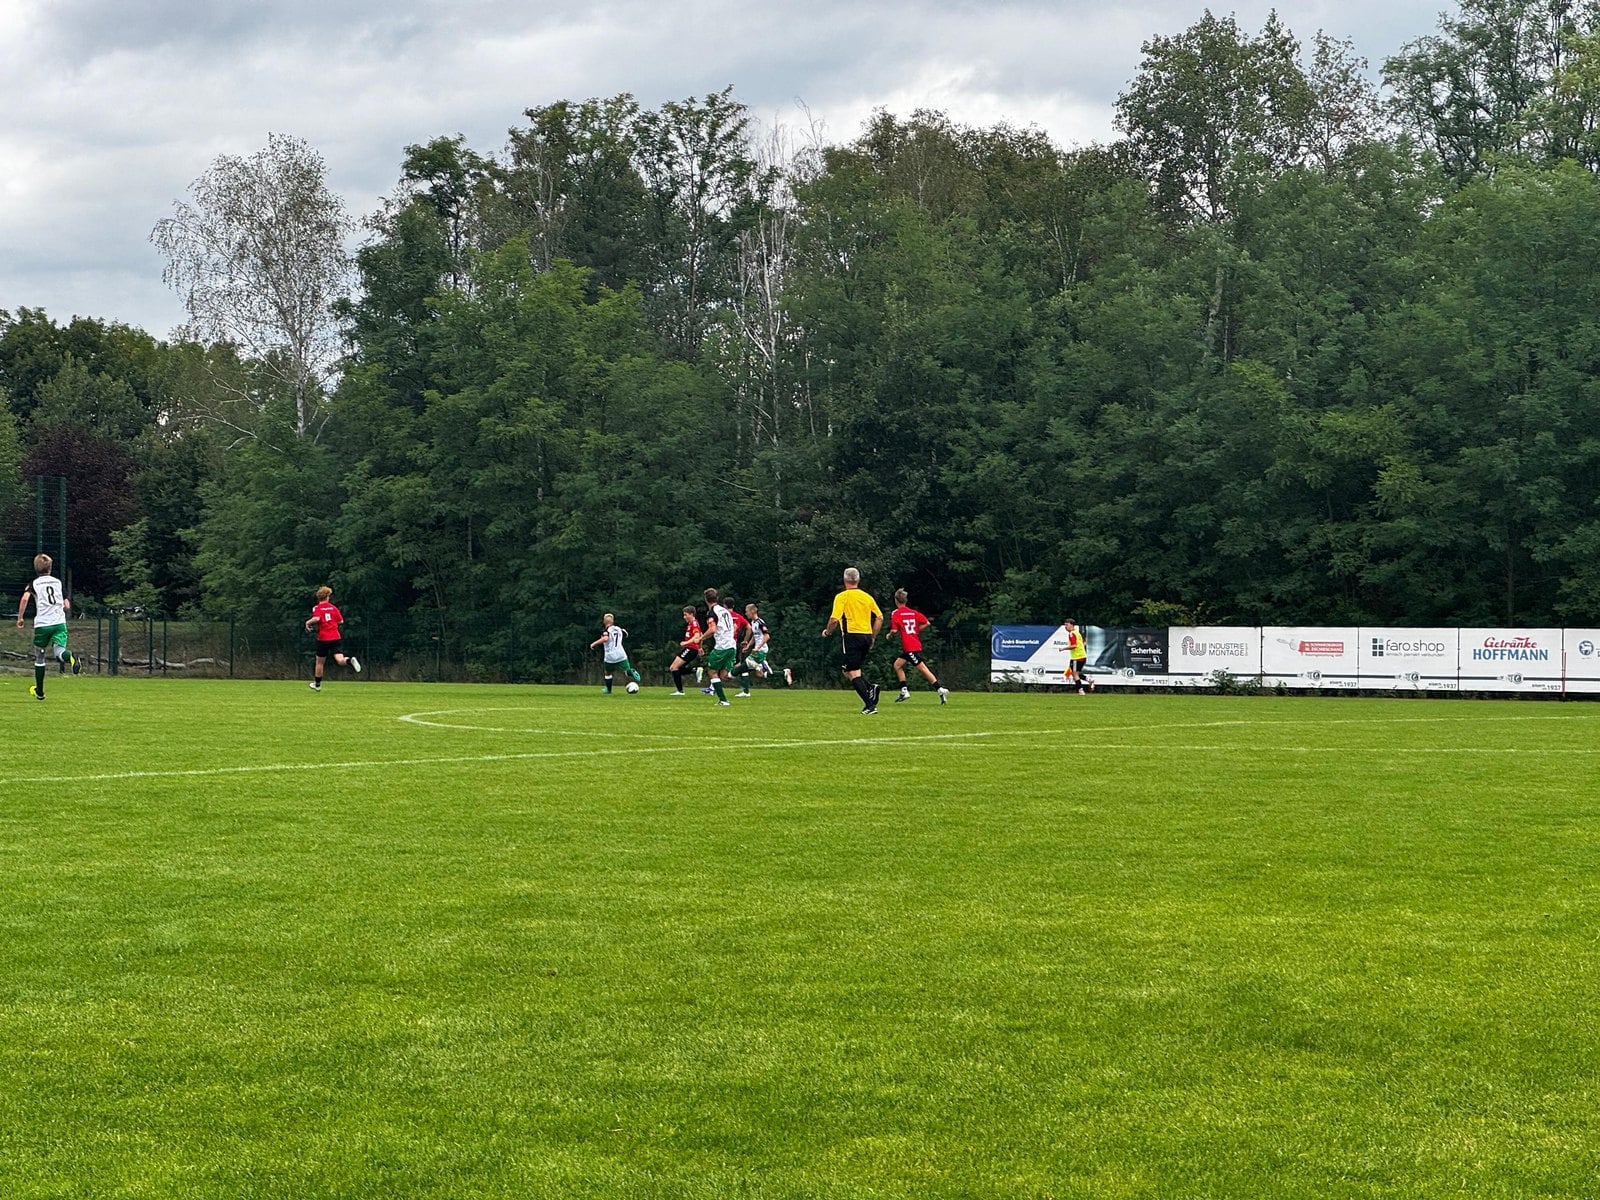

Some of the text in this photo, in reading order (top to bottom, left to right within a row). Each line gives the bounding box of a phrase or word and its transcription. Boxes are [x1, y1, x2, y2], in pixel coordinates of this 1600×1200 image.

[46, 586, 56, 605] 8
[902, 618, 917, 635] 22
[613, 632, 619, 648] 7
[1208, 642, 1245, 650] INDUSTRIE
[1386, 639, 1446, 654] faro.shop
[1472, 648, 1549, 661] HOFFMANN
